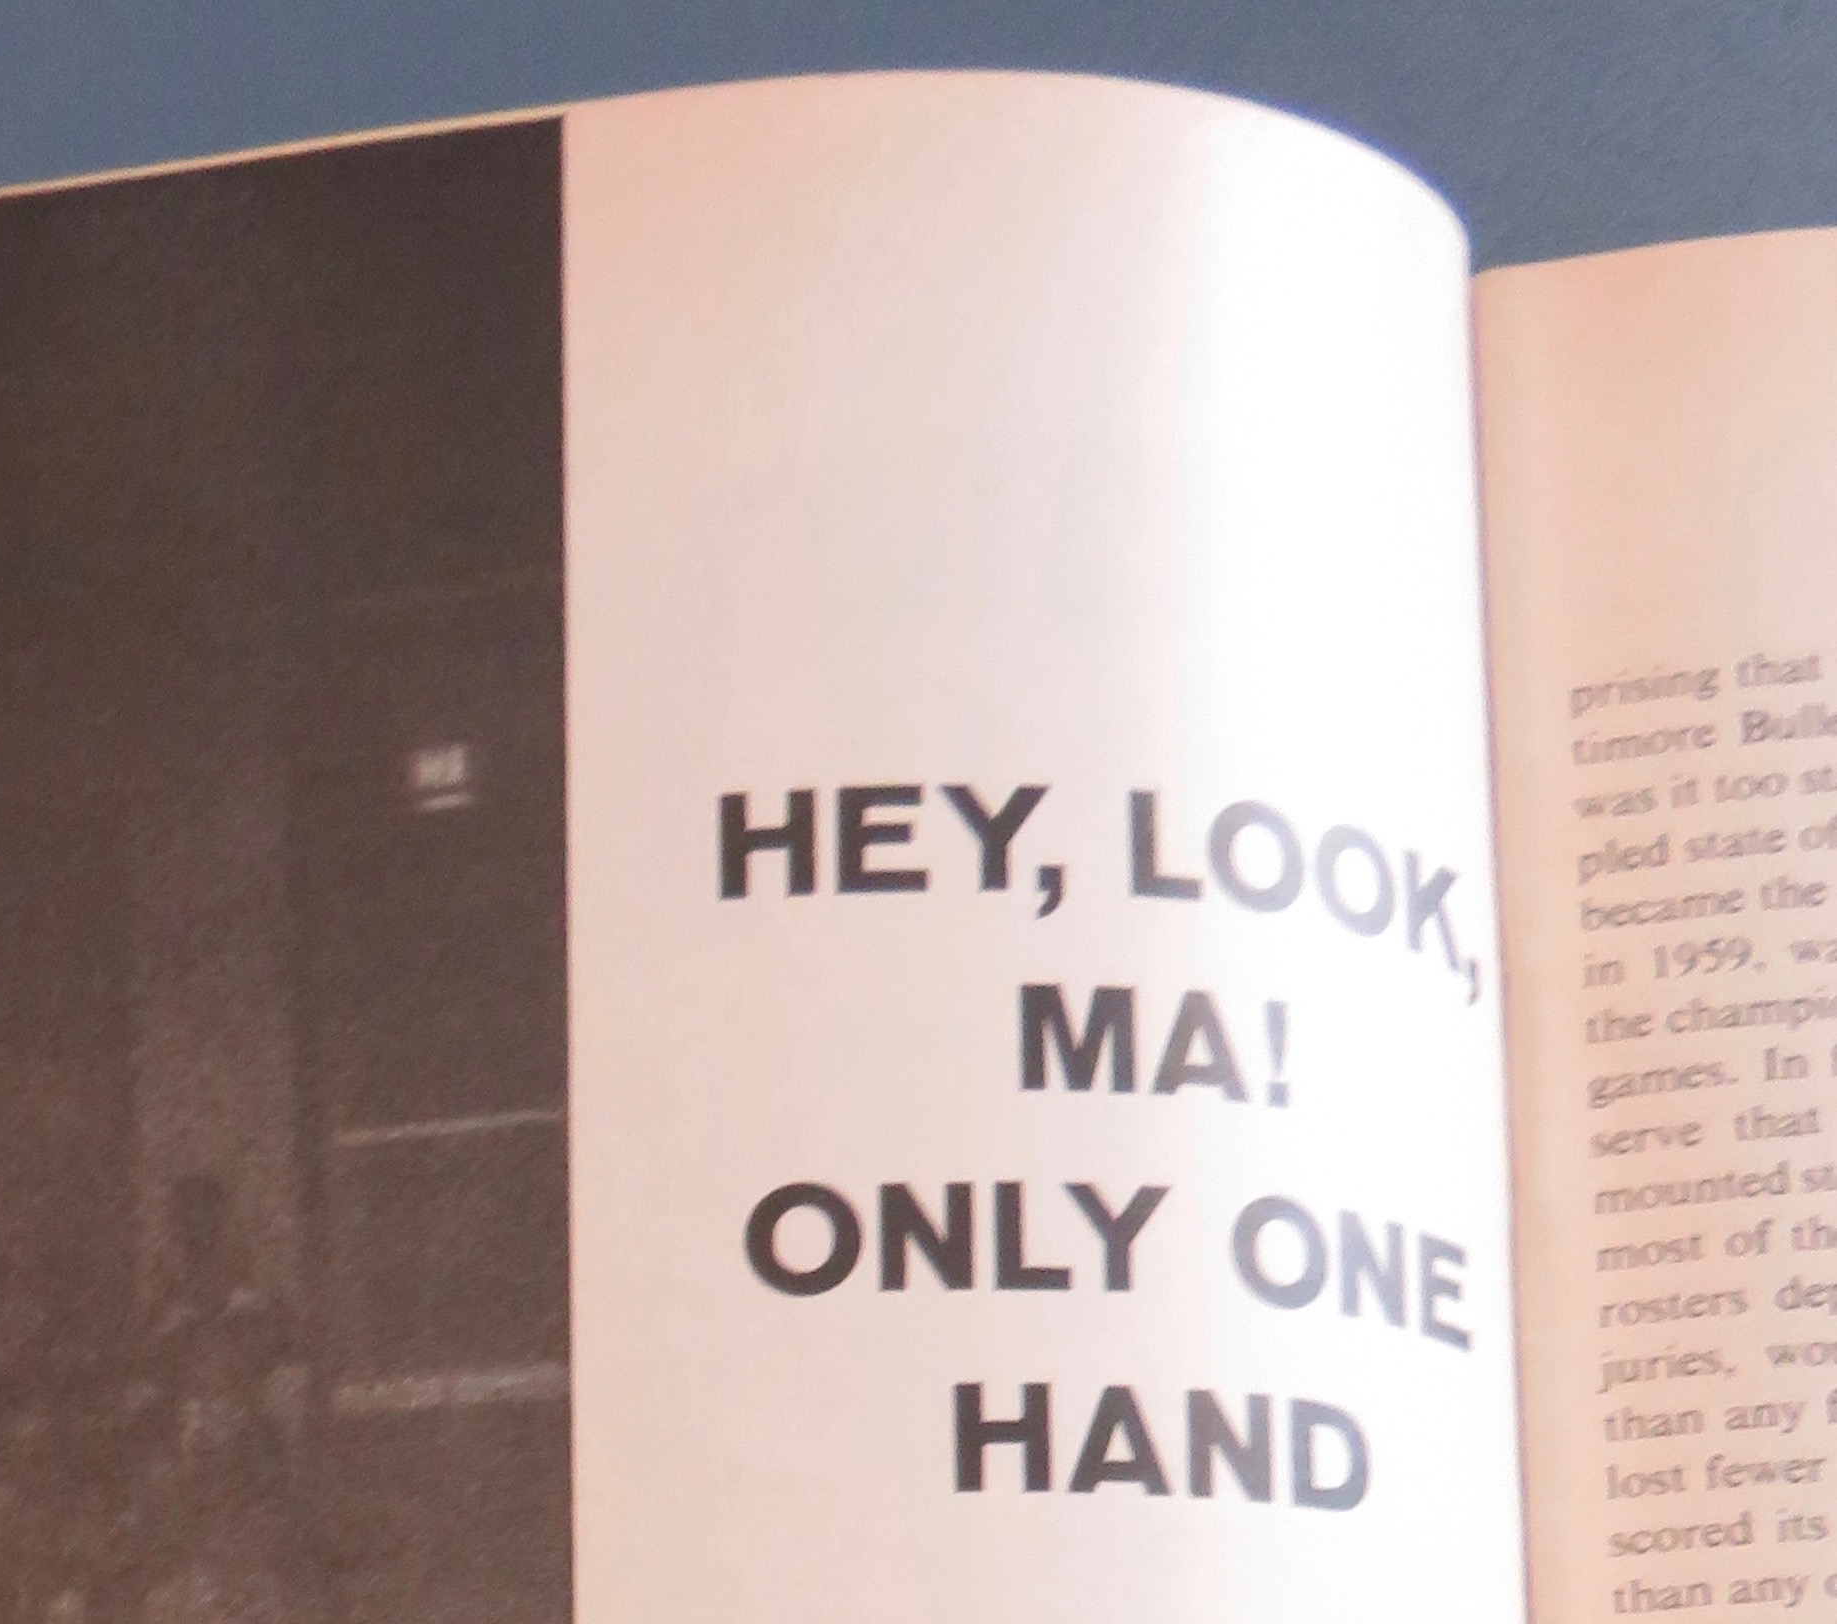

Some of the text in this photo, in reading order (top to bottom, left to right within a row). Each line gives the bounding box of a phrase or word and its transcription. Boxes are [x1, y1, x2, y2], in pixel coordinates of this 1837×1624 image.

[1736, 652, 1822, 688] that
[1683, 827, 1788, 863] state
[718, 784, 1480, 1006] HEY, LOOK,
[1580, 876, 1827, 931] became the
[1584, 952, 1626, 990] in
[1018, 983, 1290, 1106] MA!
[1764, 1046, 1809, 1082] In
[744, 1180, 1473, 1352] ONLY ONE
[953, 1382, 1368, 1510] HAND
[1603, 1401, 1805, 1442] than any
[1605, 1453, 1827, 1501] lost fewer
[1609, 1507, 1830, 1558] scored its
